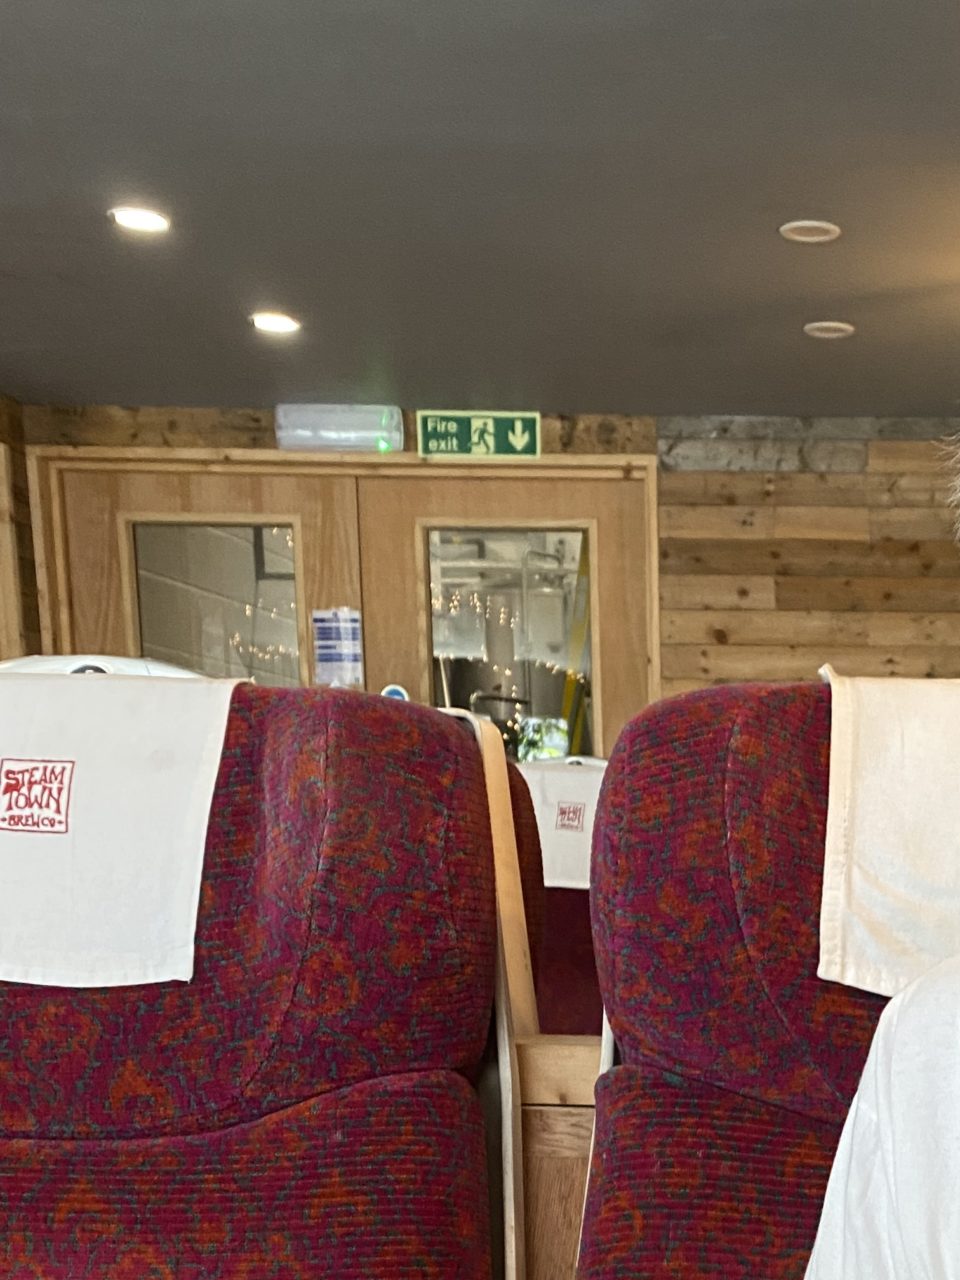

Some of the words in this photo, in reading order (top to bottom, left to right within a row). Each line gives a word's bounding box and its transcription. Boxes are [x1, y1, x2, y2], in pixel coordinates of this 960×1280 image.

[428, 417, 458, 433] Fire
[429, 436, 459, 451] exit
[4, 765, 66, 786] STEAM
[3, 783, 63, 815] TOWN
